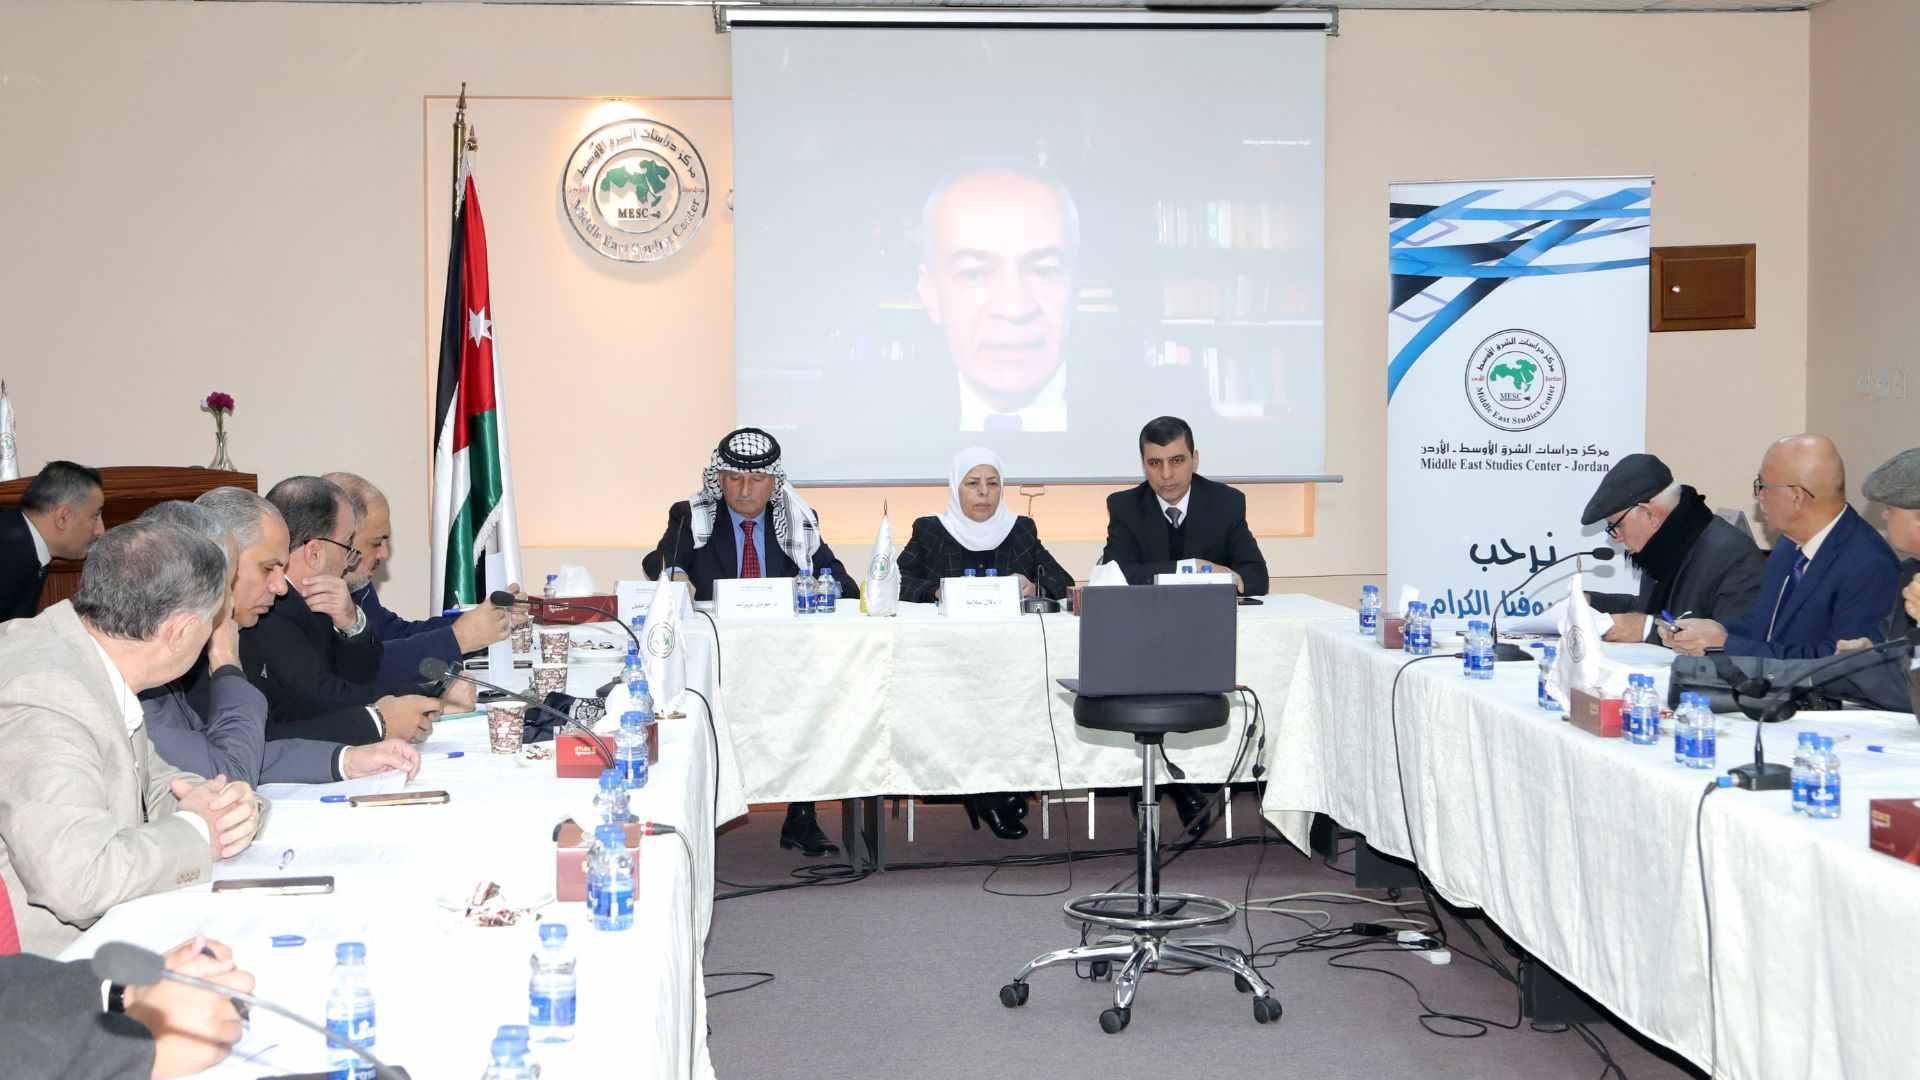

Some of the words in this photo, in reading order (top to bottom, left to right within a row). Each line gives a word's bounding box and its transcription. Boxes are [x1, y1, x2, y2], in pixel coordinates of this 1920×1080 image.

[618, 208, 649, 218] MESC
[1476, 385, 1493, 413] Middle
[1492, 410, 1510, 424] East
[1511, 410, 1541, 424] Studies
[1540, 385, 1556, 411] Center
[1420, 439, 1450, 455] الأردن
[1459, 439, 1498, 456] الأوسط
[1501, 443, 1531, 455] الشرق
[1535, 443, 1578, 457] دراسات
[1581, 444, 1609, 457] مركز
[1420, 458, 1457, 470] Middle
[1460, 458, 1482, 470] East
[1485, 459, 1523, 471] Studies
[1526, 460, 1562, 472] Center
[1571, 460, 1609, 473] Jordan
[1469, 531, 1557, 574] نرحب
[1430, 588, 1491, 619] الكرام
